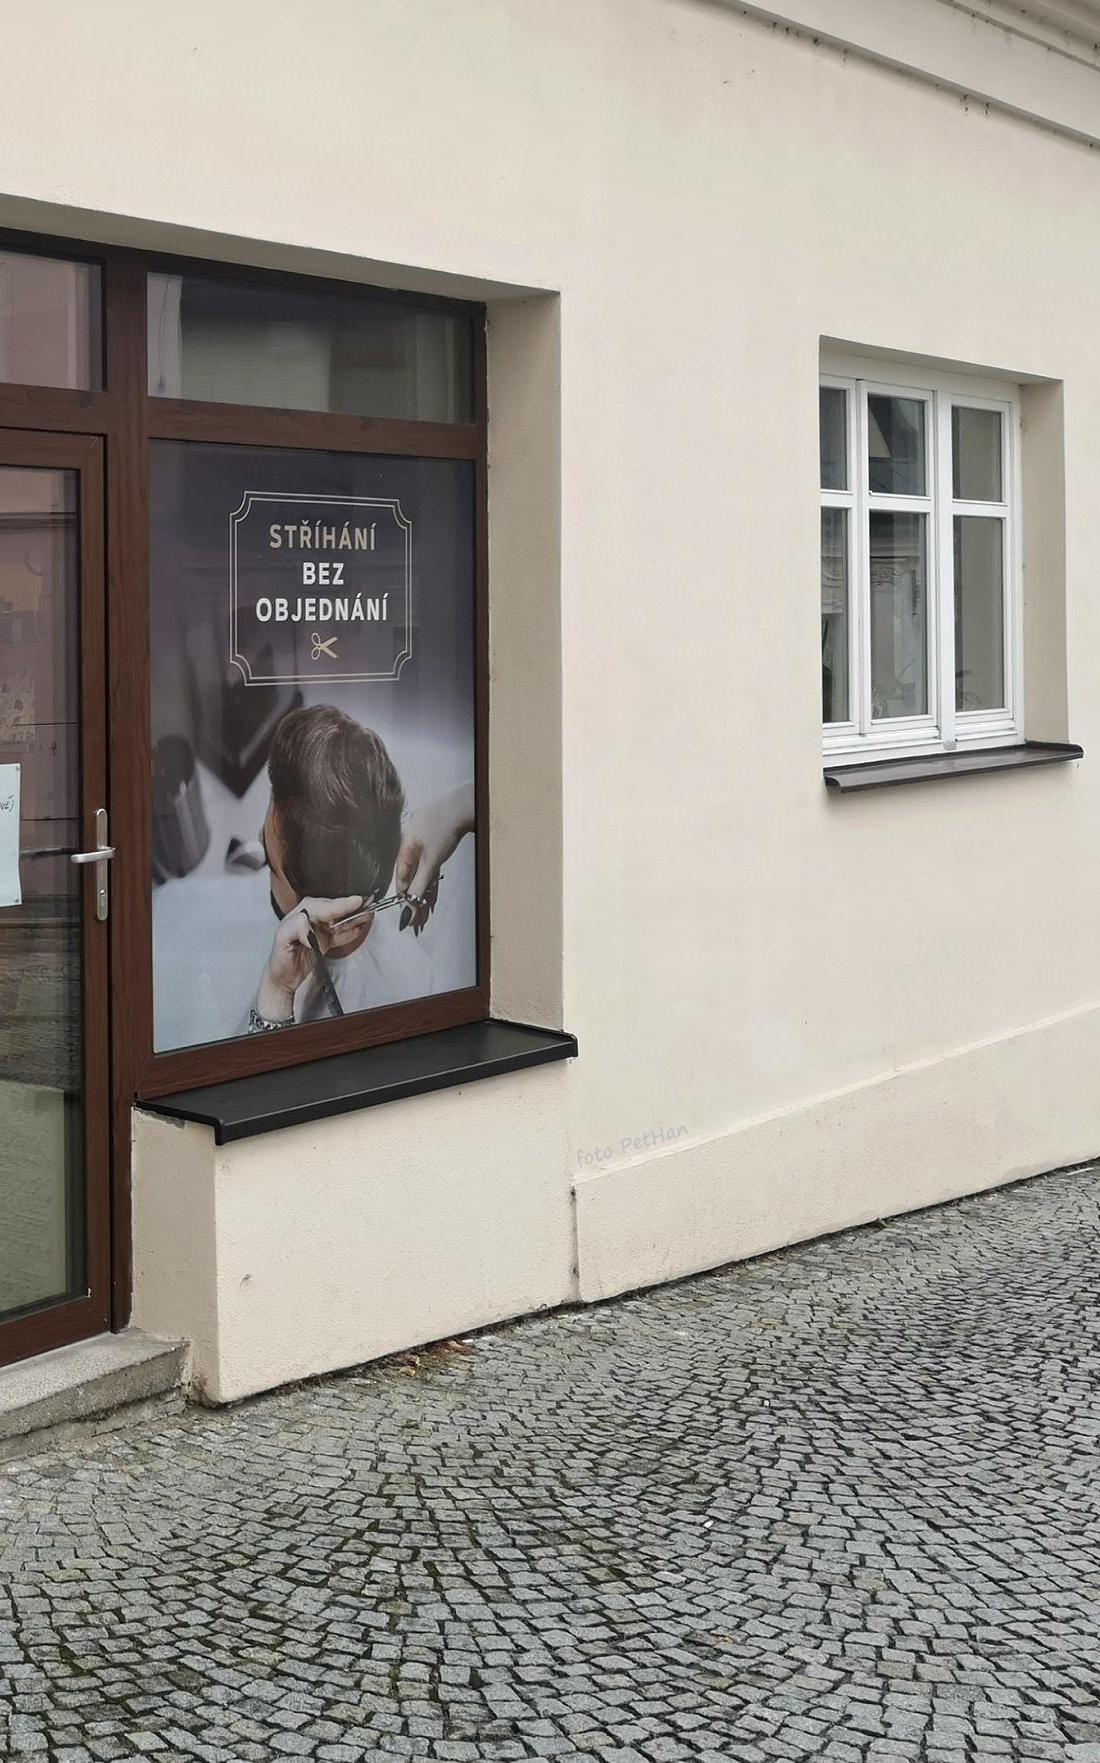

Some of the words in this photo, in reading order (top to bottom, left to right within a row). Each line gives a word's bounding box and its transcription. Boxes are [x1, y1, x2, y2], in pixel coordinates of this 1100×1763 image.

[269, 520, 378, 550] STŘÍHÁNÍ
[302, 562, 345, 585] BEZ
[256, 593, 389, 622] OBJEDNÁNÍ
